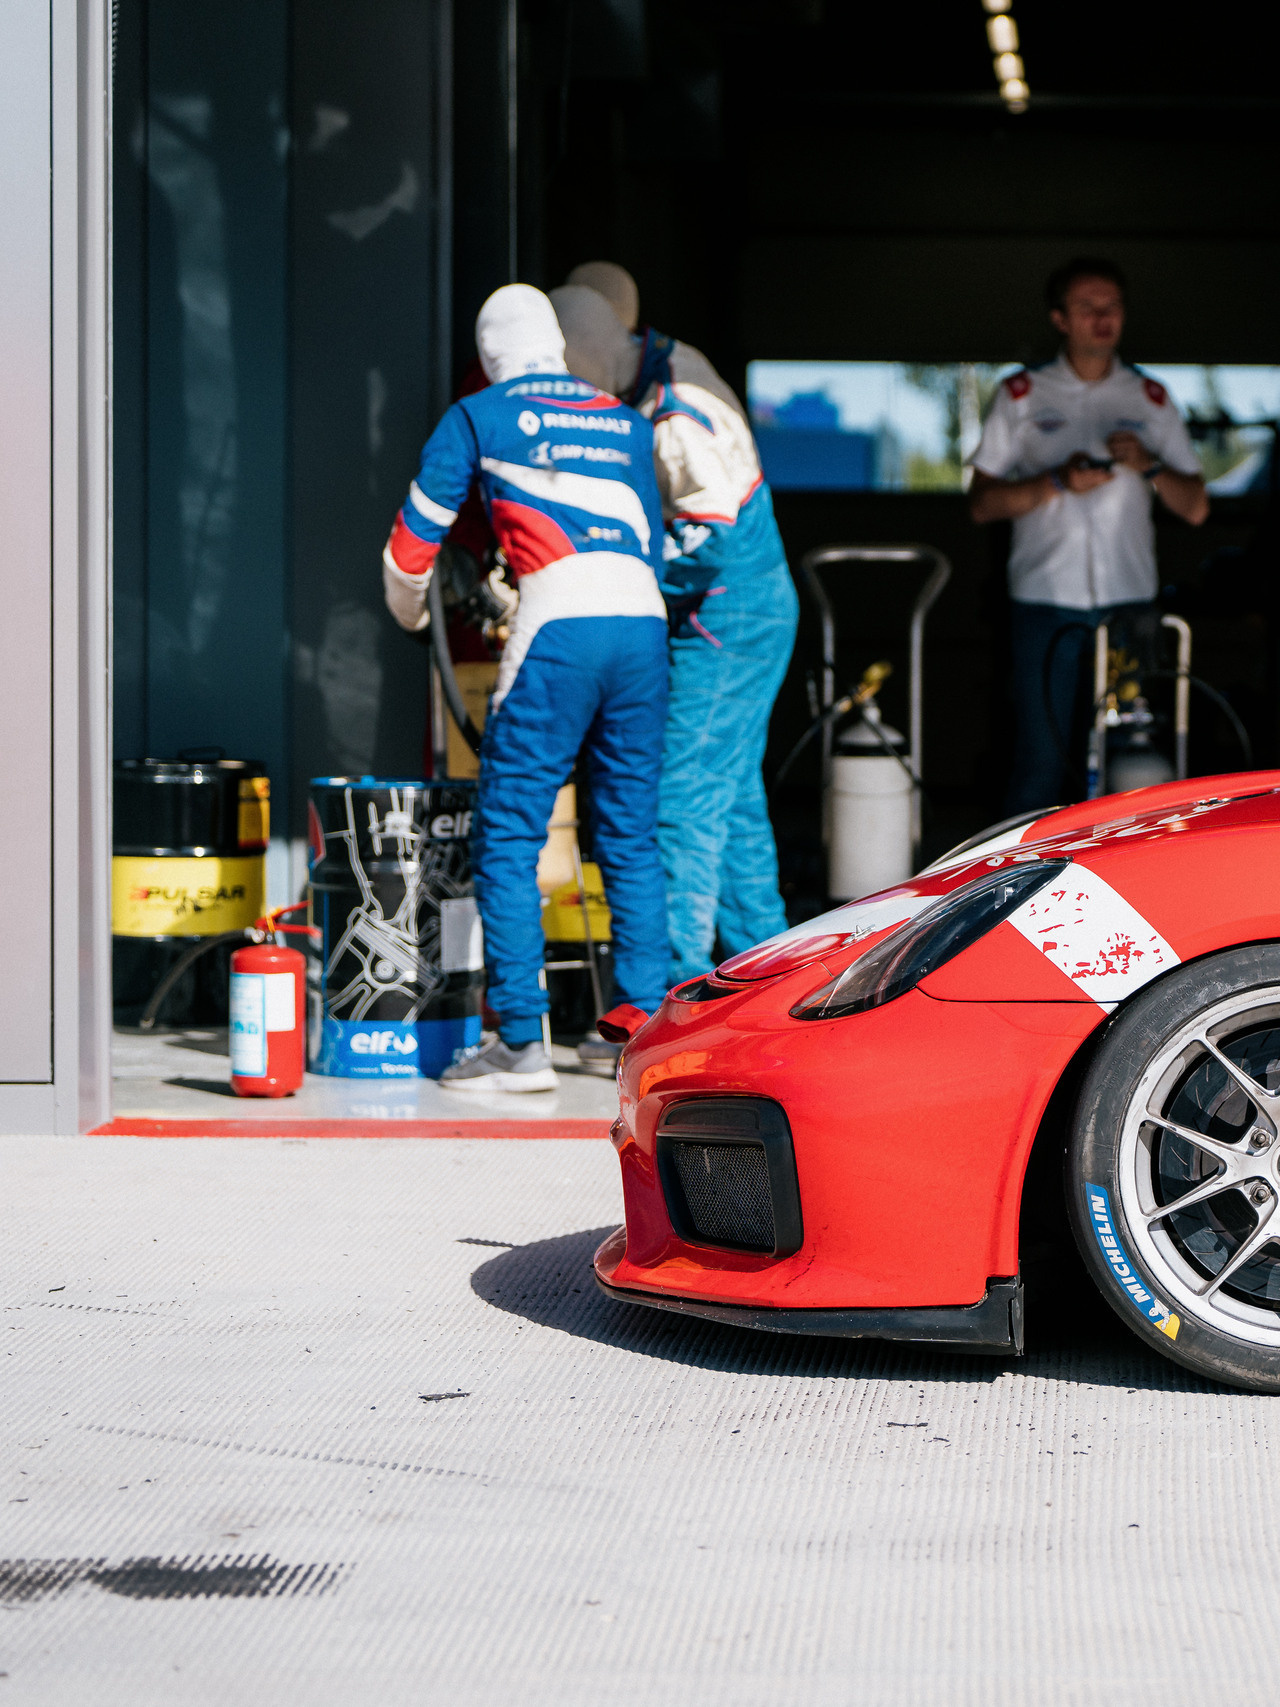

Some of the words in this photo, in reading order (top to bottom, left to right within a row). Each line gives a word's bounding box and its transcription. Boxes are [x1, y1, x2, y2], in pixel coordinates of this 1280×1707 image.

[542, 412, 632, 435] RENAULT
[431, 810, 473, 838] elf
[350, 1031, 396, 1055] elf
[1090, 1194, 1149, 1304] MICHELIN
